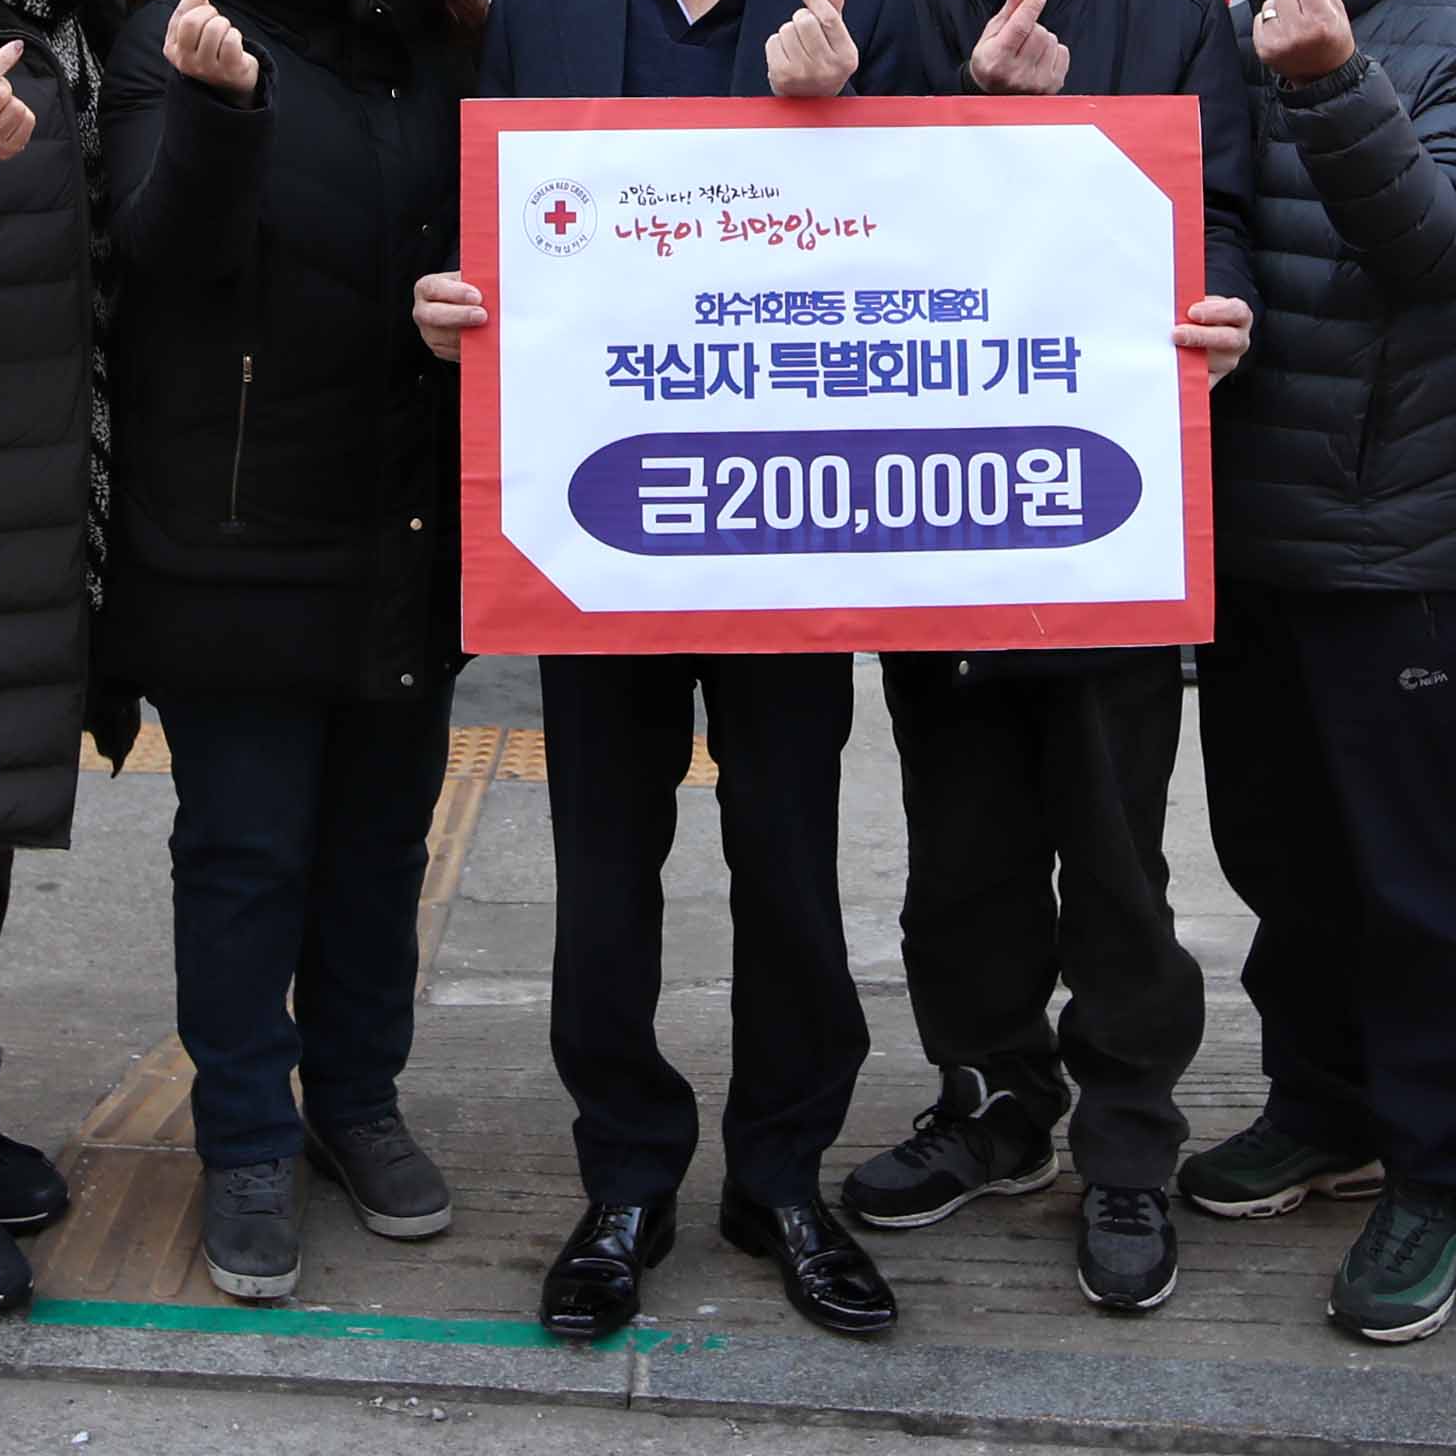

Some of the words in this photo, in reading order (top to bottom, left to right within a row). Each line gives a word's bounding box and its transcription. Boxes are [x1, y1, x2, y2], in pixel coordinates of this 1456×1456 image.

[530, 182, 555, 206] KOREAN
[555, 181, 570, 191] RED
[570, 184, 590, 205] CROSS
[618, 184, 692, 206] 고맙습니다!
[698, 185, 780, 204] 적십자회비
[615, 215, 703, 257] 나눔이
[716, 208, 878, 251] 희망입니다
[605, 341, 761, 401] 적십자
[768, 339, 970, 399] 특별회비
[982, 334, 1082, 395] 기탁
[636, 446, 1085, 536] 금200,000원
